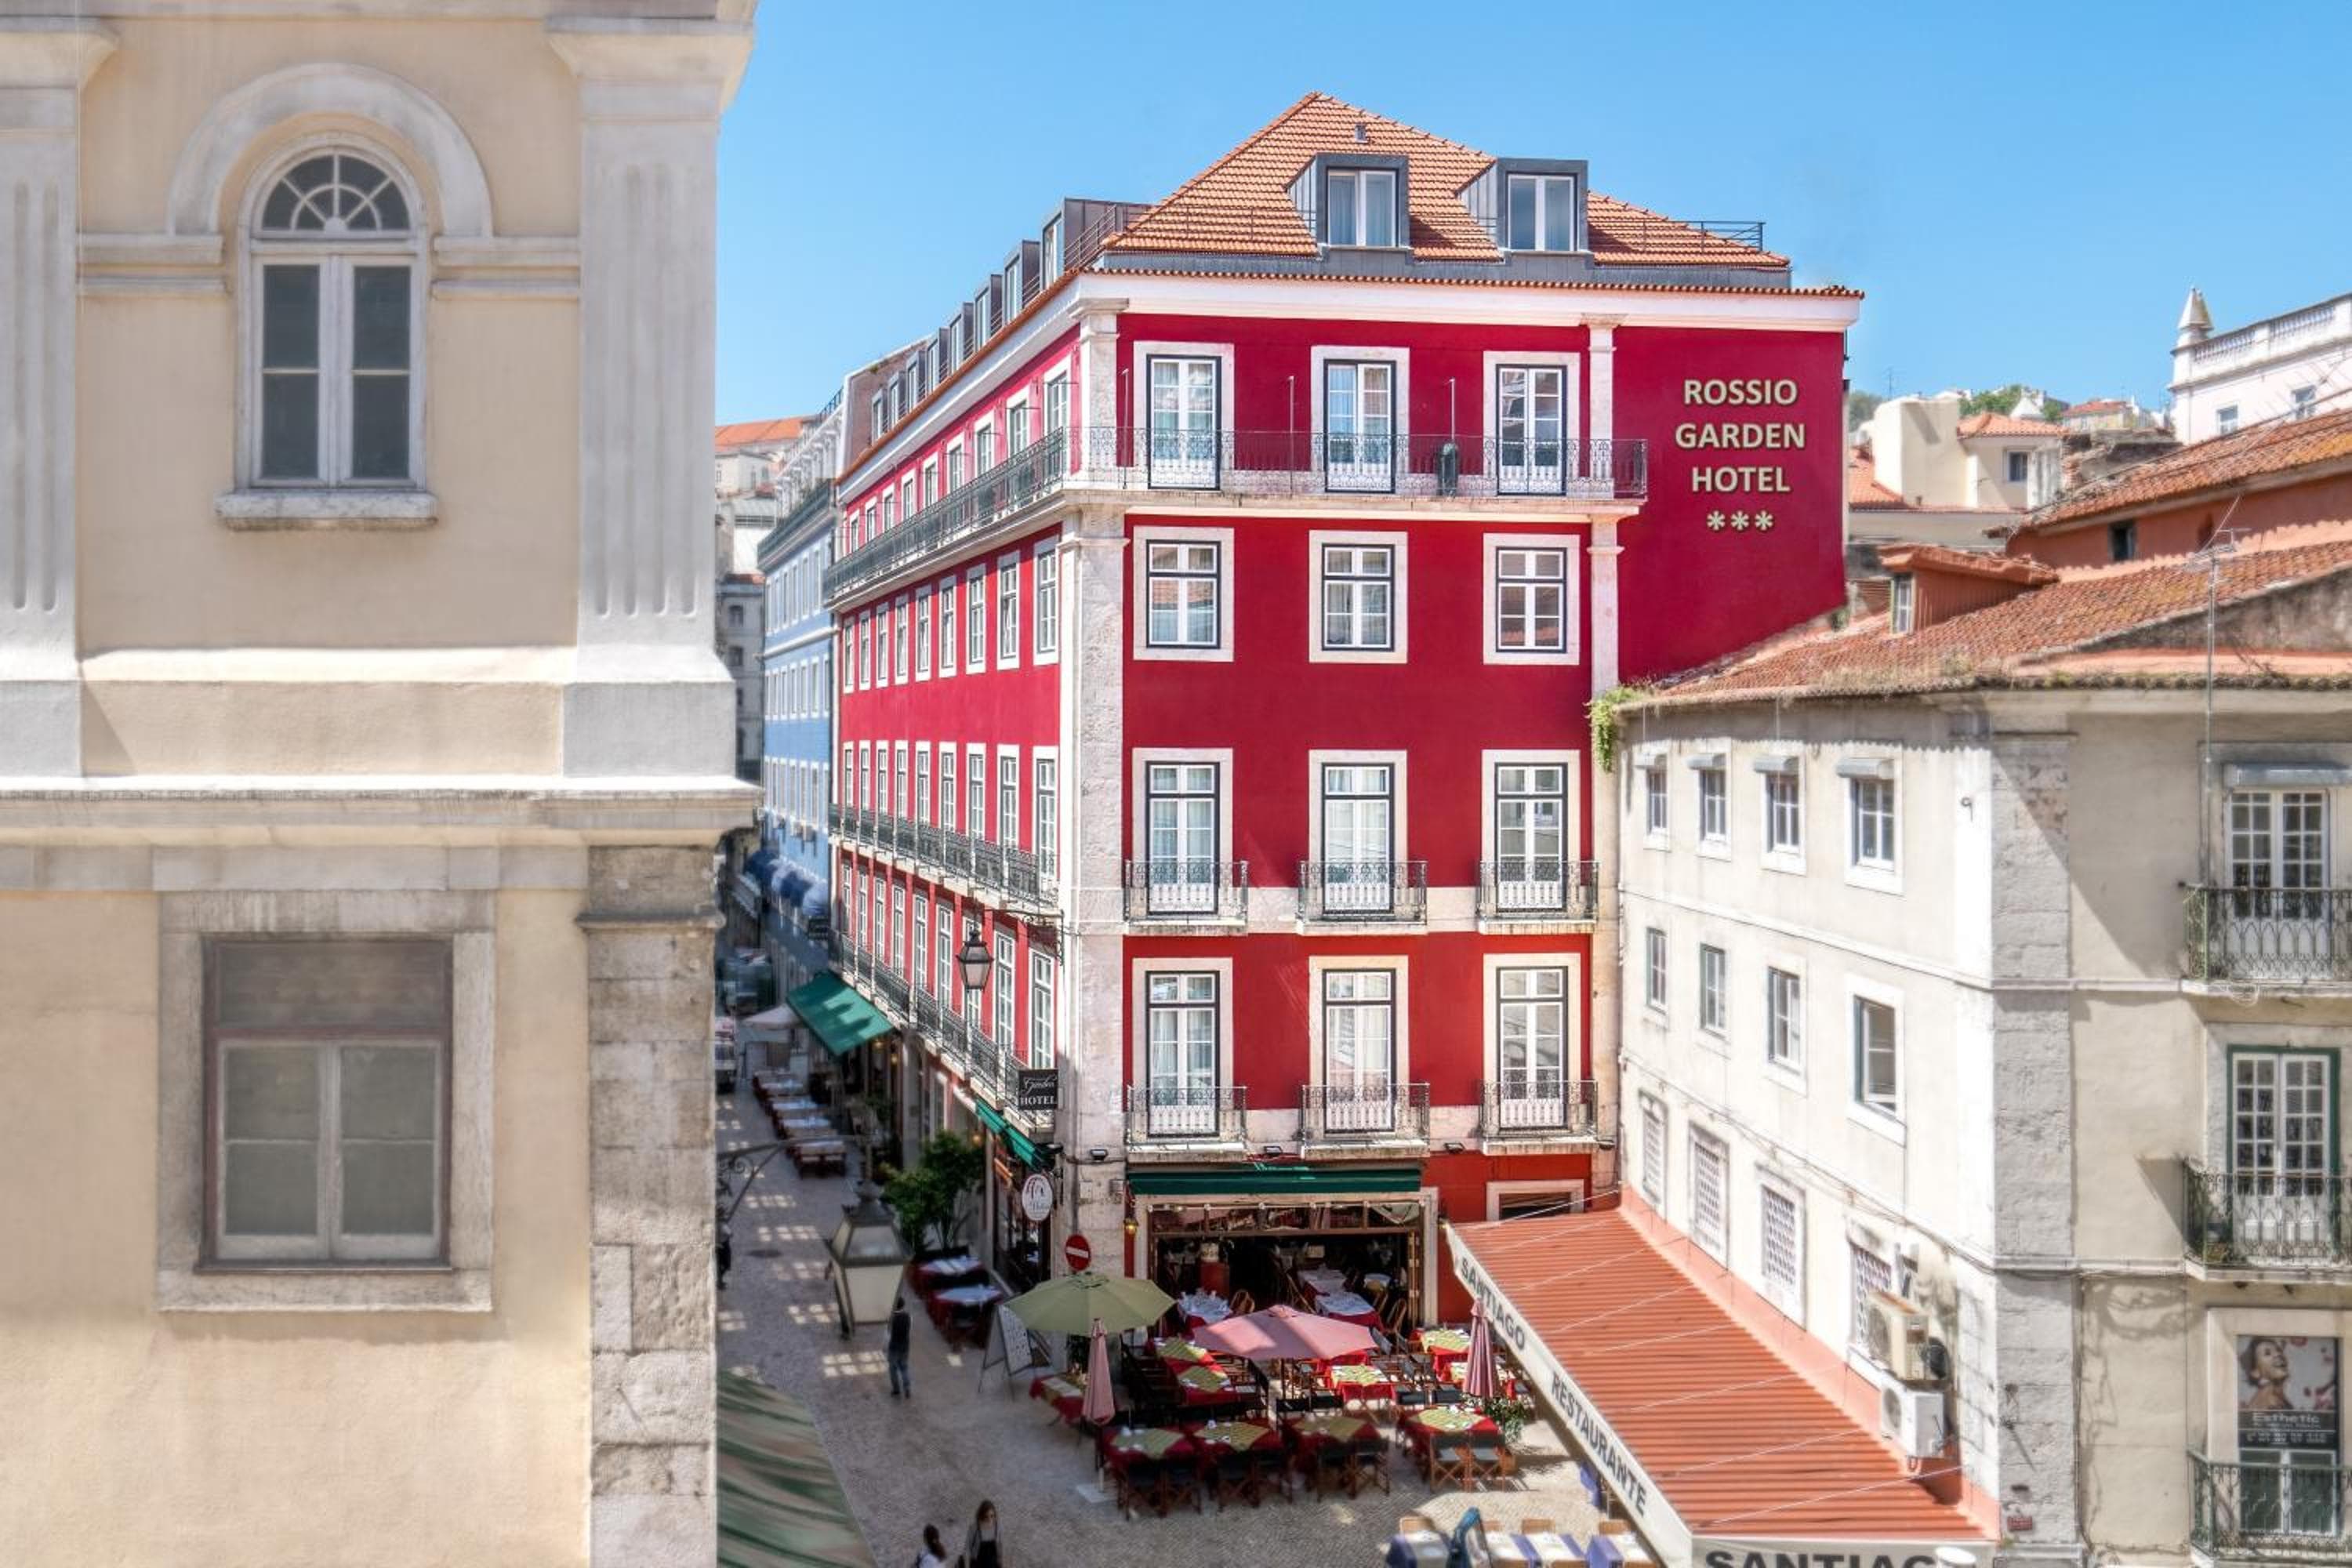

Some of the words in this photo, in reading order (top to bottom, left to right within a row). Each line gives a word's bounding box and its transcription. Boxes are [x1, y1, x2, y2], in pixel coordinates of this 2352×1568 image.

[1684, 379, 1798, 405] ROSSIO
[1675, 423, 1806, 449] GARDEN
[1692, 466, 1791, 492] HOTEL
[1020, 1095, 1055, 1105] HOTEL
[1461, 1257, 1525, 1350] SANTIAGO
[1552, 1372, 1646, 1516] RESTAURANTE
